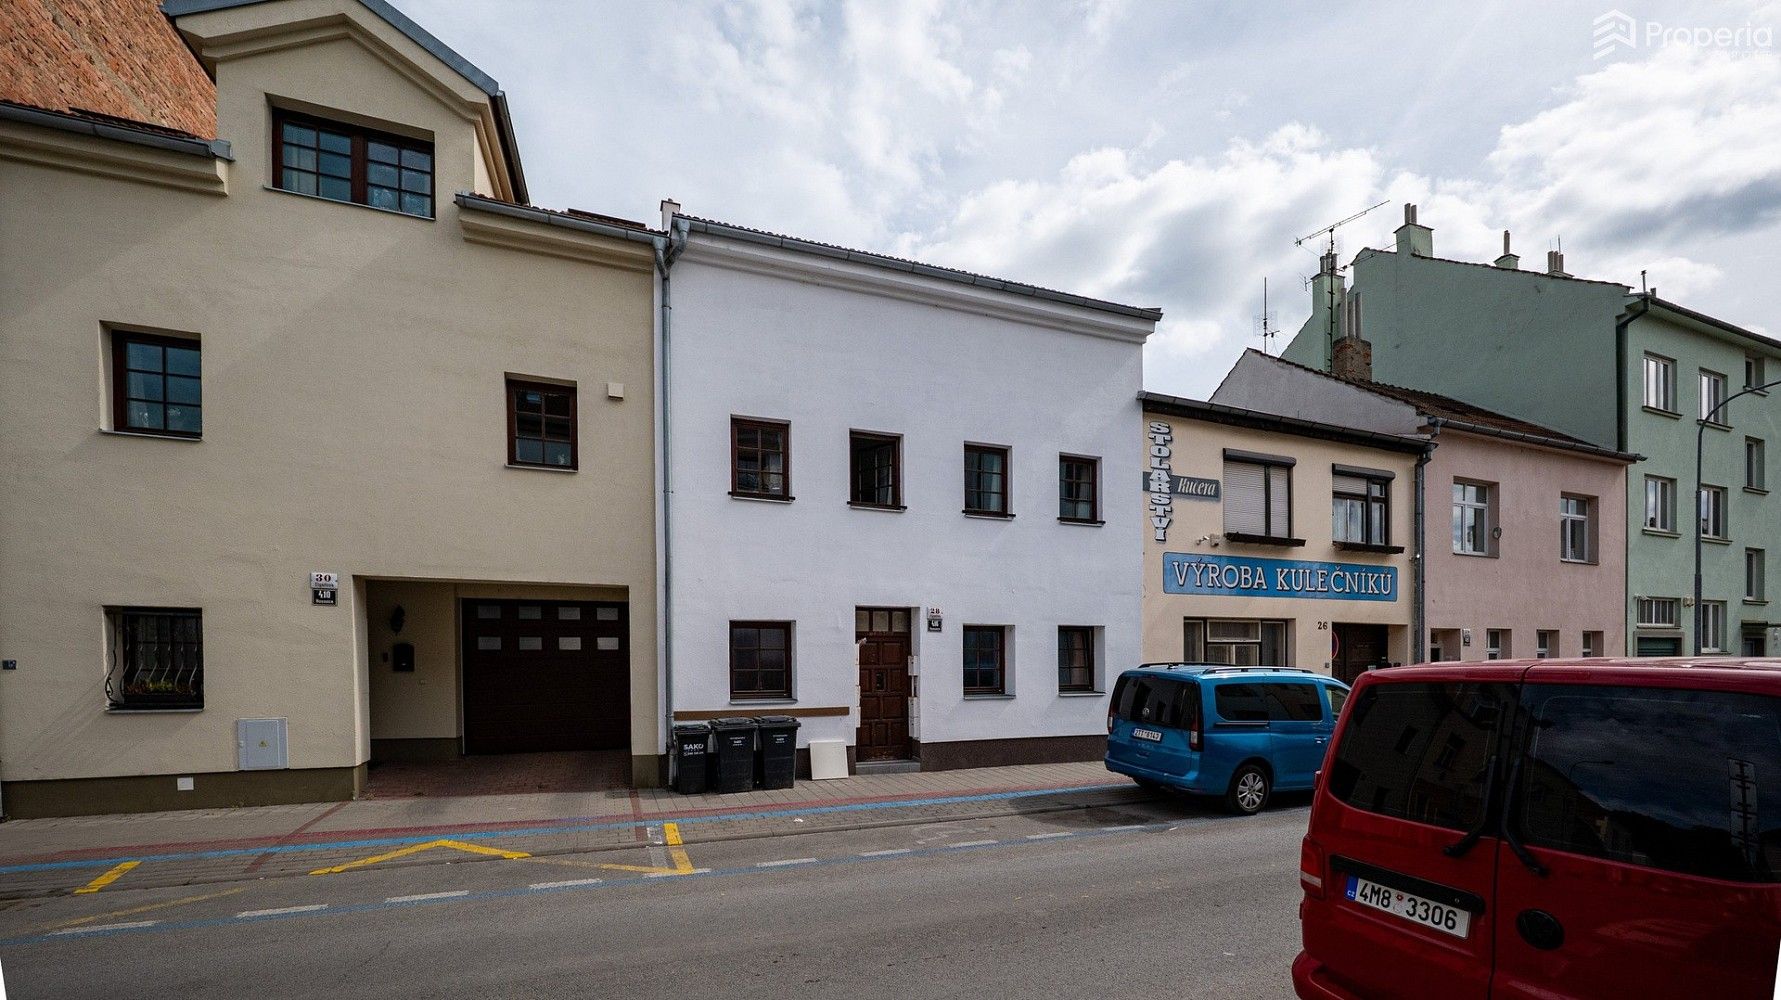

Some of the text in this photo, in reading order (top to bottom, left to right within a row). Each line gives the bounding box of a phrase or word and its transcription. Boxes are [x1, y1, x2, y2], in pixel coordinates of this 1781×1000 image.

[315, 573, 332, 582] 30
[1173, 559, 1392, 595] VÝROBA KULEČNÍKŮ
[318, 590, 331, 599] 410
[1317, 621, 1328, 630] 26
[1359, 882, 1459, 931] 4M8 3306
